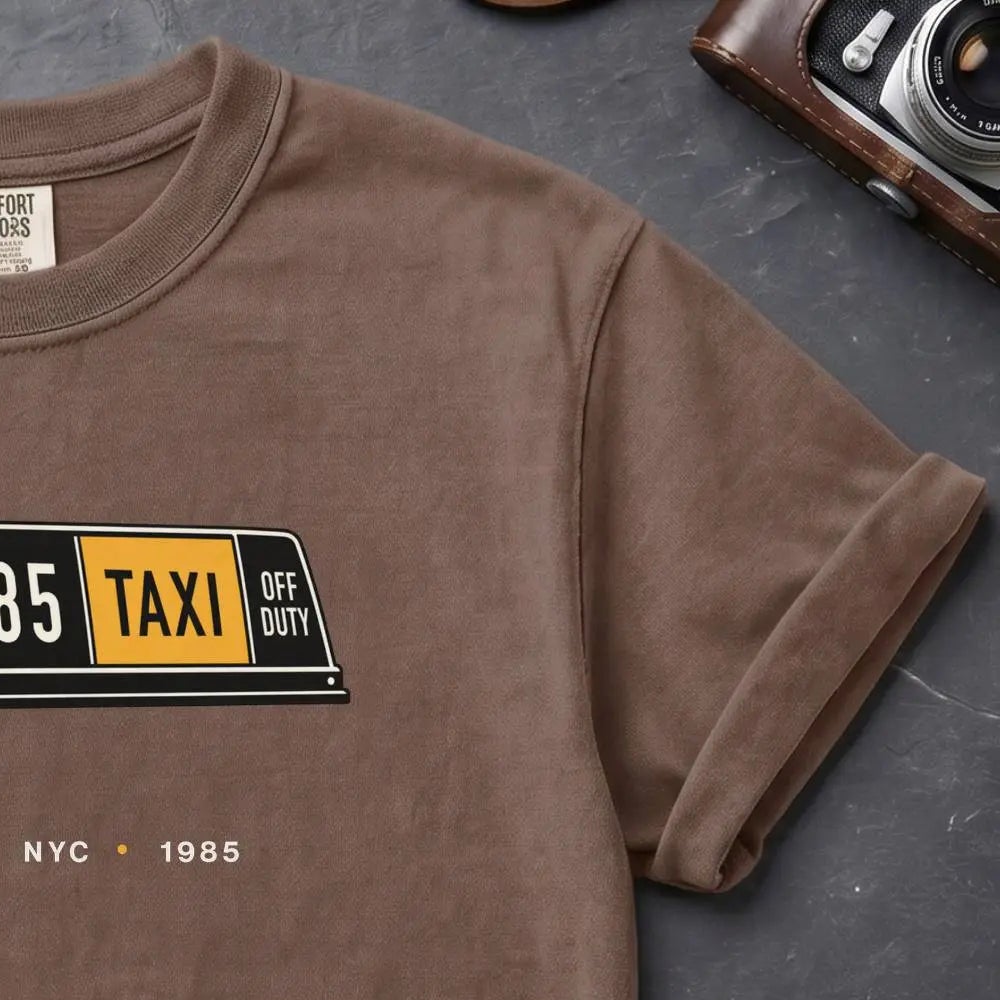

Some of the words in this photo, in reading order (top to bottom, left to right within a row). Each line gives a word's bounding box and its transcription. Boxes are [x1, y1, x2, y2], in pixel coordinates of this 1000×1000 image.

[260, 570, 298, 601] OFF
[103, 568, 224, 637] TAXI
[260, 606, 310, 637] DUTY
[23, 840, 90, 863] NYC
[160, 840, 240, 863] 1985
